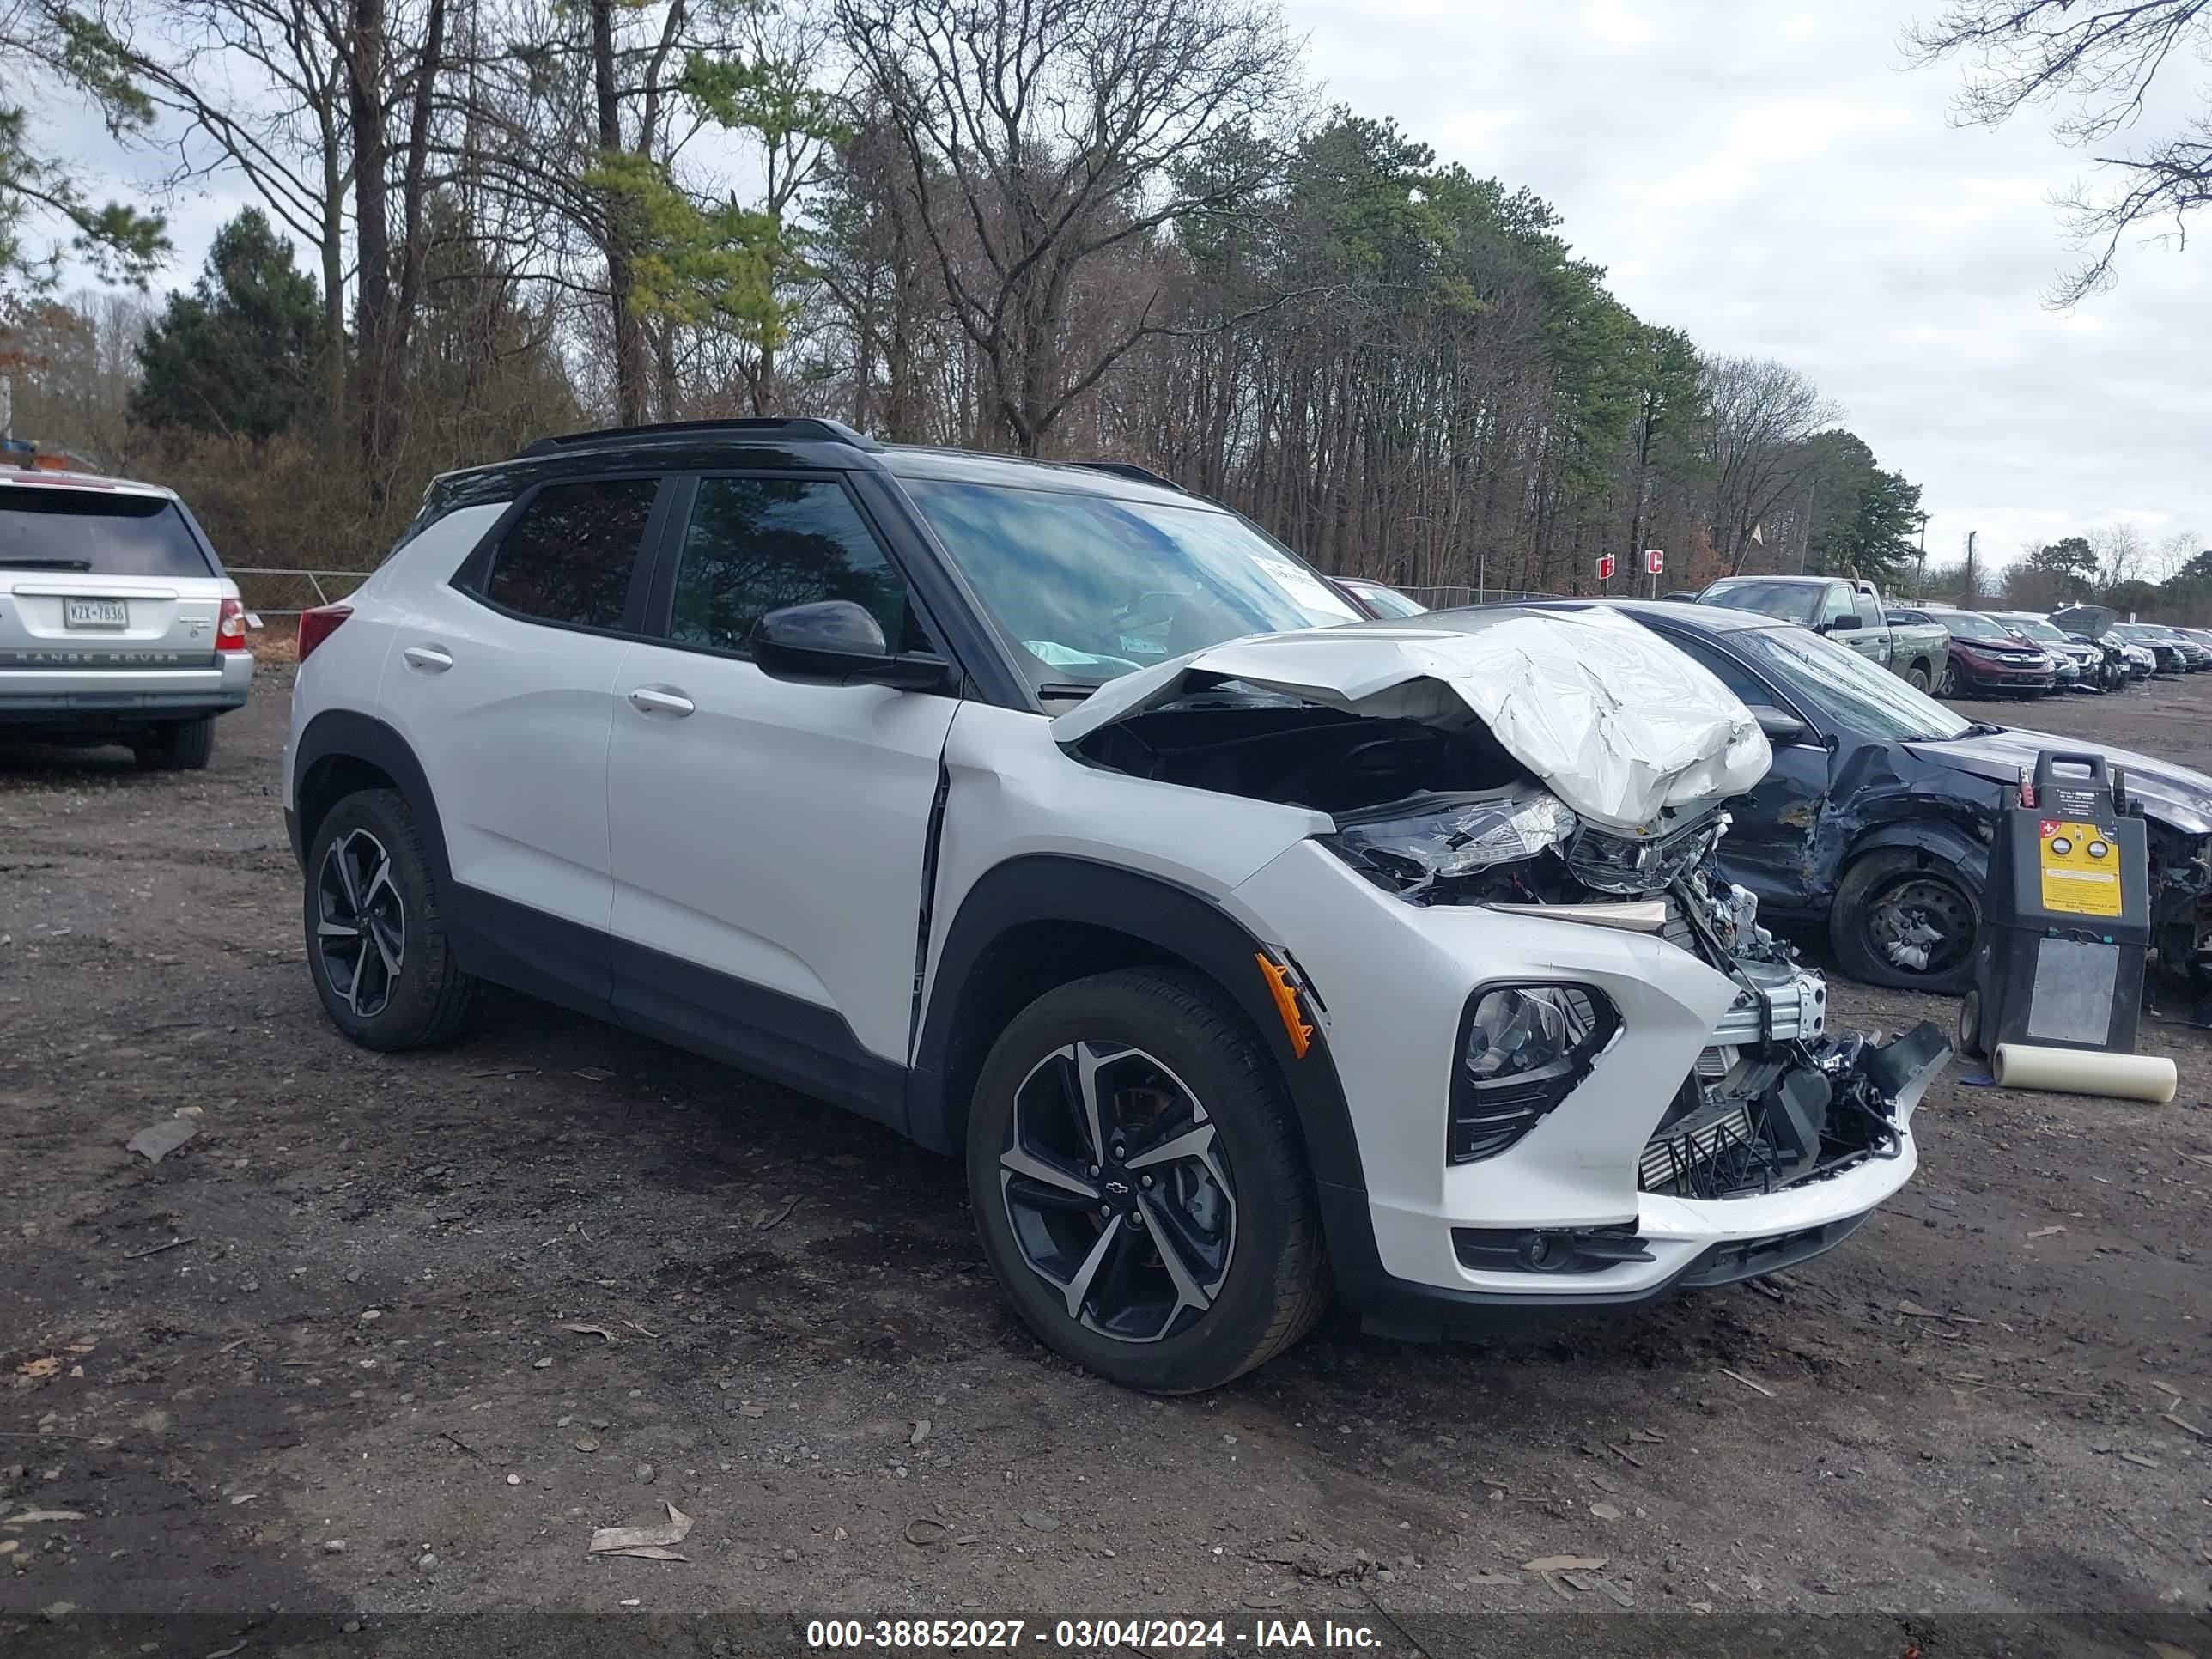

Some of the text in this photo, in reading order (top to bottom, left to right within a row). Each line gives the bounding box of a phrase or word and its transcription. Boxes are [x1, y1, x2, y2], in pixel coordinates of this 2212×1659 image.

[1601, 557, 1613, 578] B
[1650, 551, 1662, 572] C
[16, 653, 178, 662] RANGE ROVER
